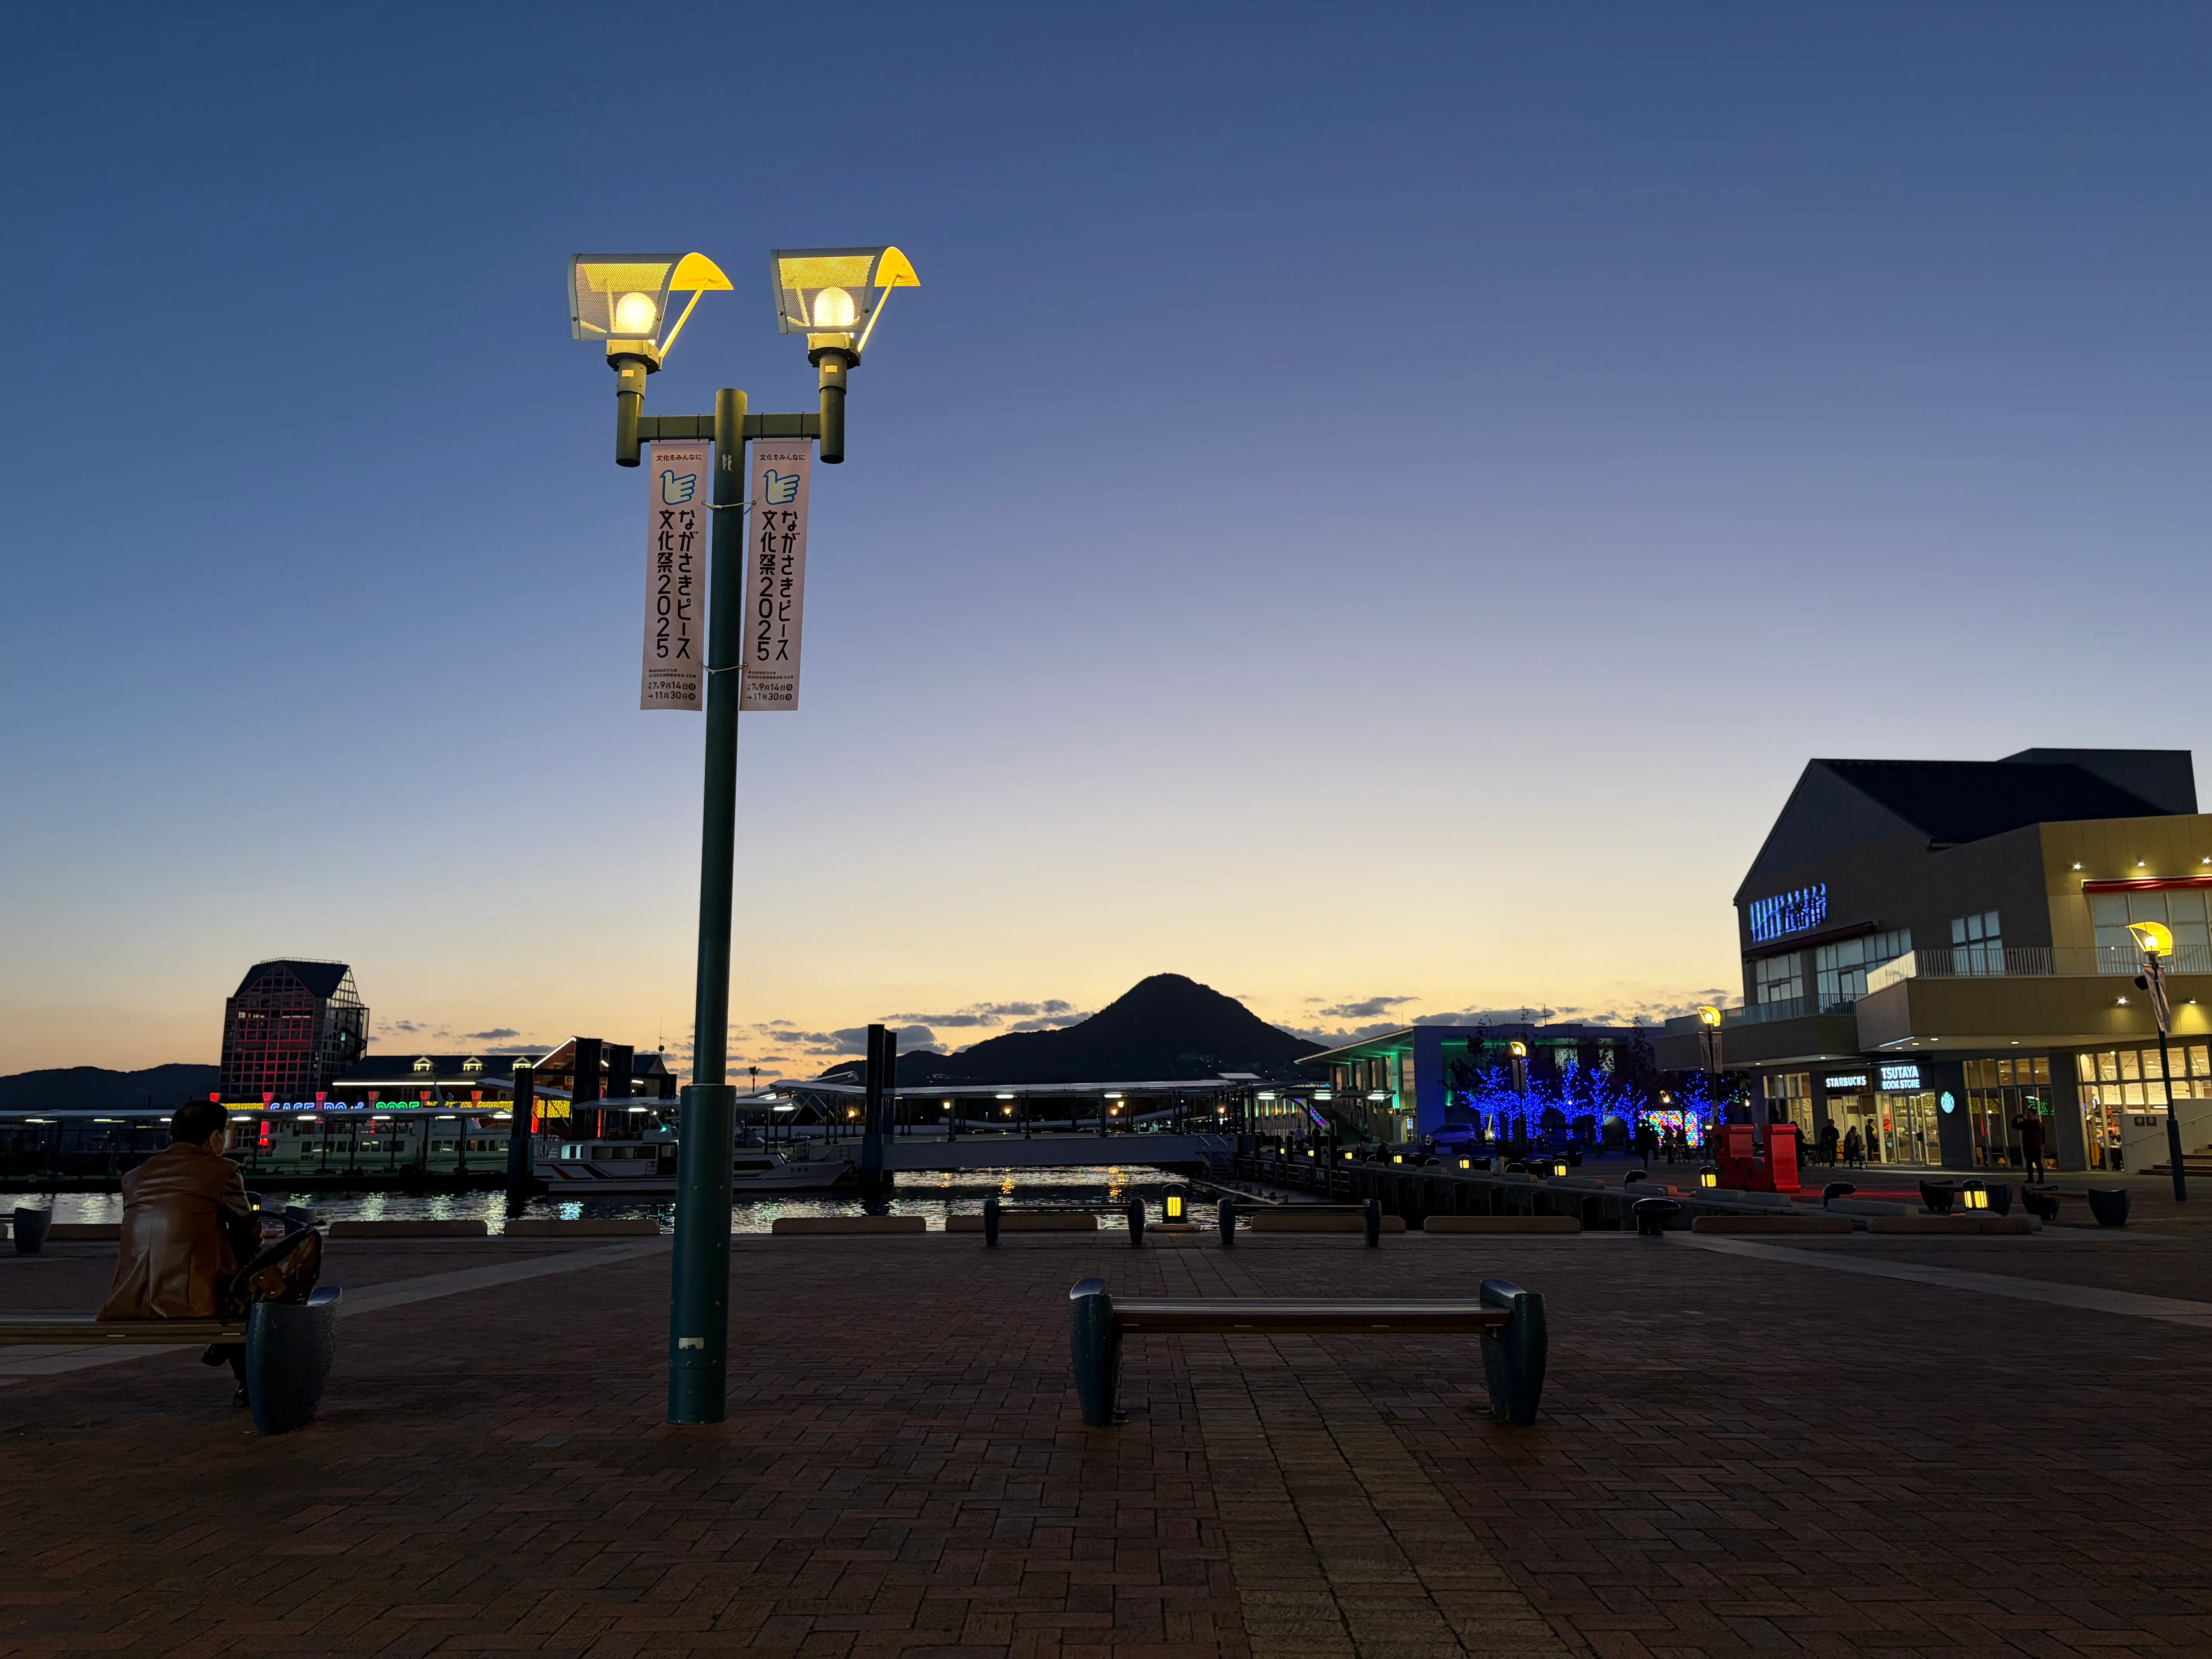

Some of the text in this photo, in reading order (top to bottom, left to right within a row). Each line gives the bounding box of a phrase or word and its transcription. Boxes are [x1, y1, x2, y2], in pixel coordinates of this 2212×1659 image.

[656, 510, 675, 658] 文化祭2025
[676, 510, 699, 659] ながさきピース
[757, 510, 778, 661] 文化祭2025
[775, 510, 800, 661] ながさきピース
[1826, 1076, 1867, 1087] STARBUCKS
[1881, 1065, 1919, 1079] TSUTAYA
[1882, 1079, 1920, 1090] BOOK STORE
